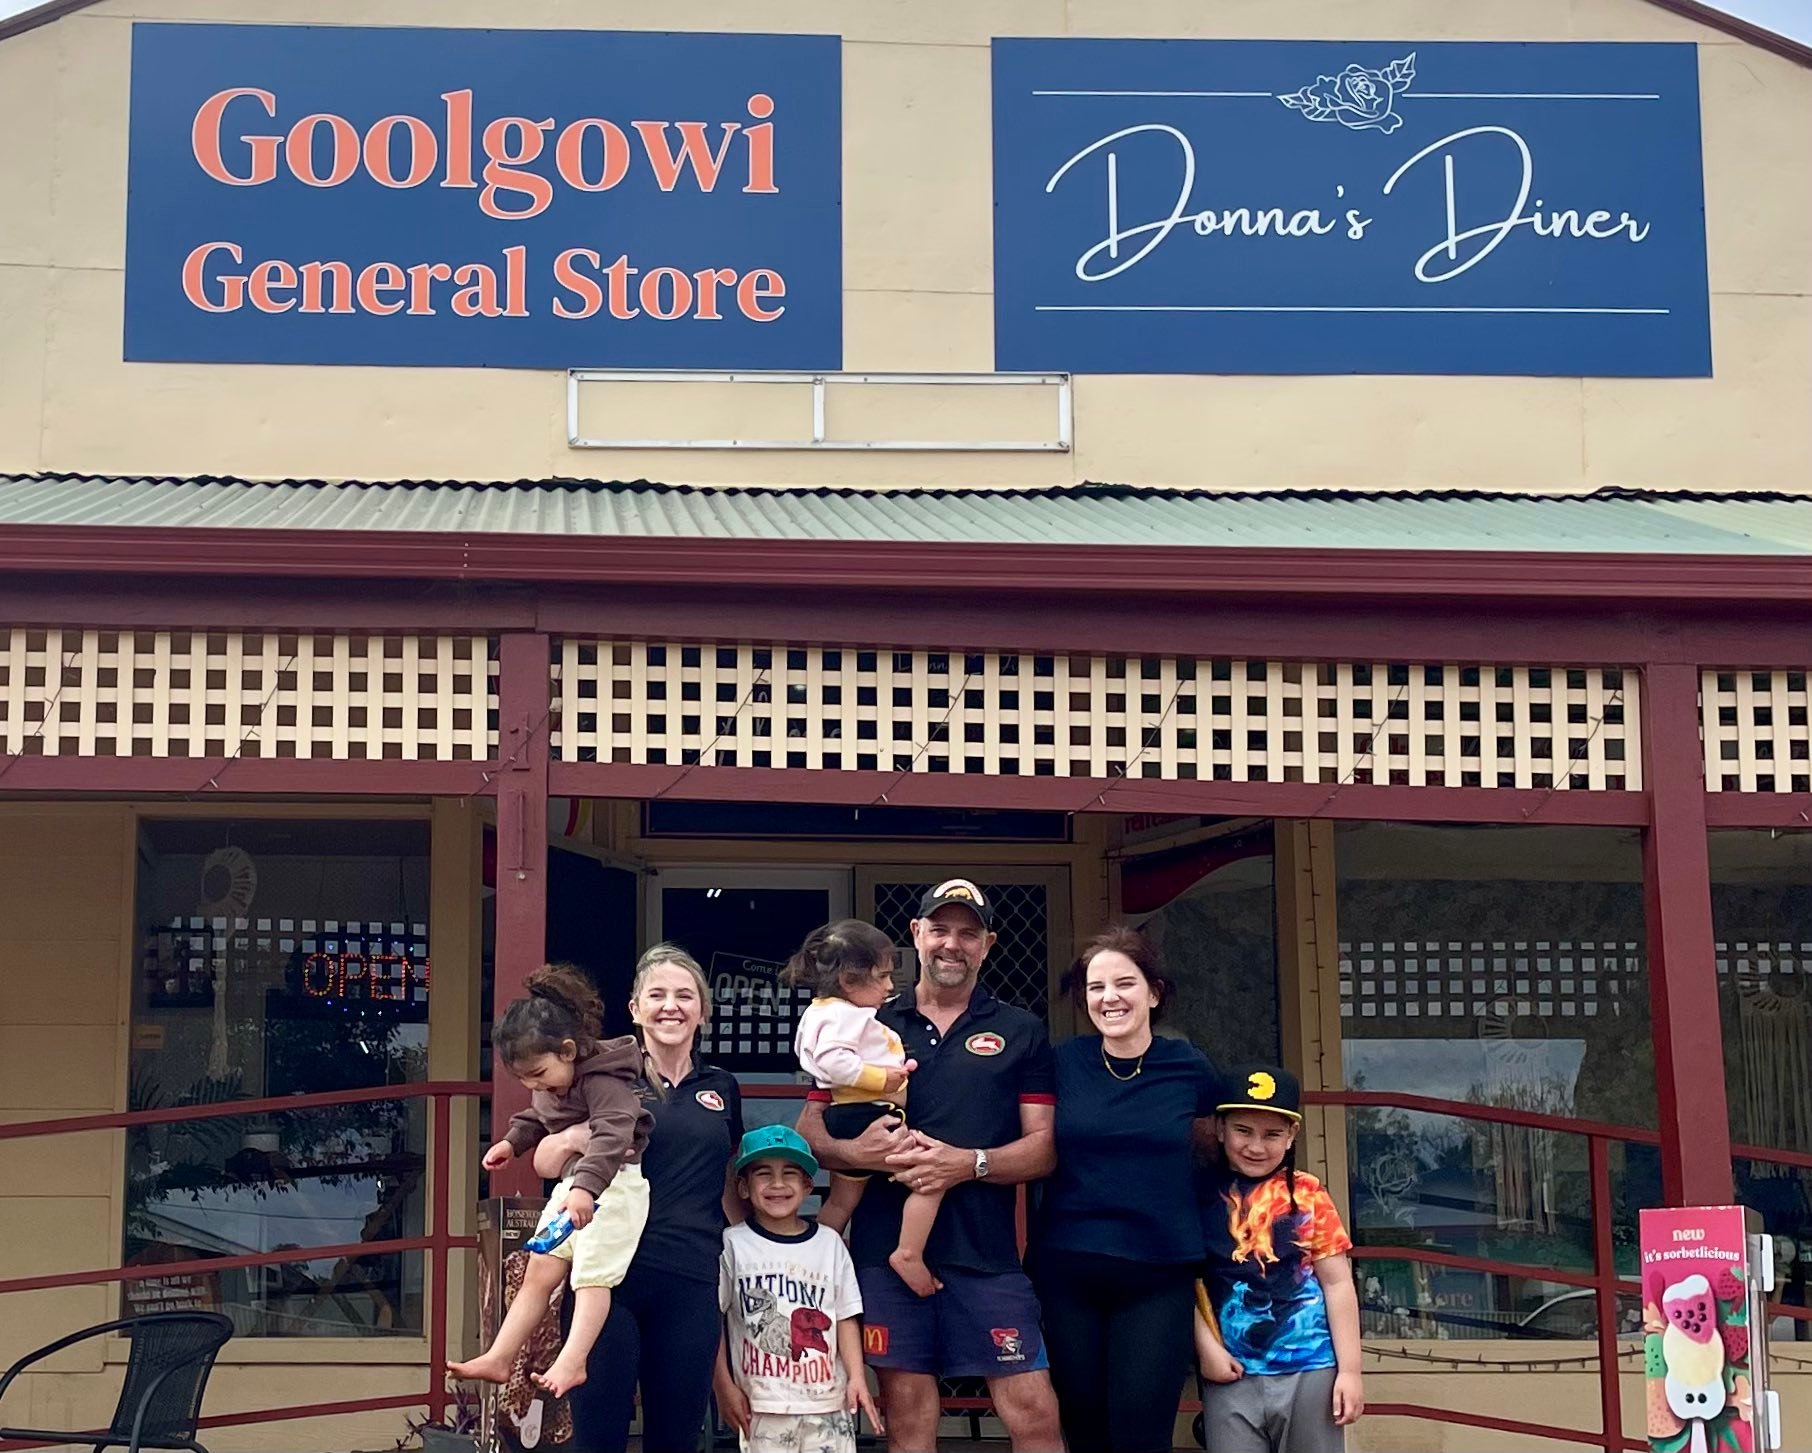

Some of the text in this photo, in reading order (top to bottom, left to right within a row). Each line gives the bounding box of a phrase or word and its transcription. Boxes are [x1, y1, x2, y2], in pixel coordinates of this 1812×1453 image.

[191, 87, 780, 220] Goolgowi
[1045, 124, 1651, 283] Donna's Diner
[182, 241, 786, 322] General Store
[304, 953, 430, 998] OPEN
[742, 959, 773, 975] Come
[715, 972, 783, 1013] OPEN
[1643, 1245, 1740, 1264] it's sorbetlicious
[1671, 1228, 1706, 1242] new
[741, 1338, 833, 1384] CHAMPION
